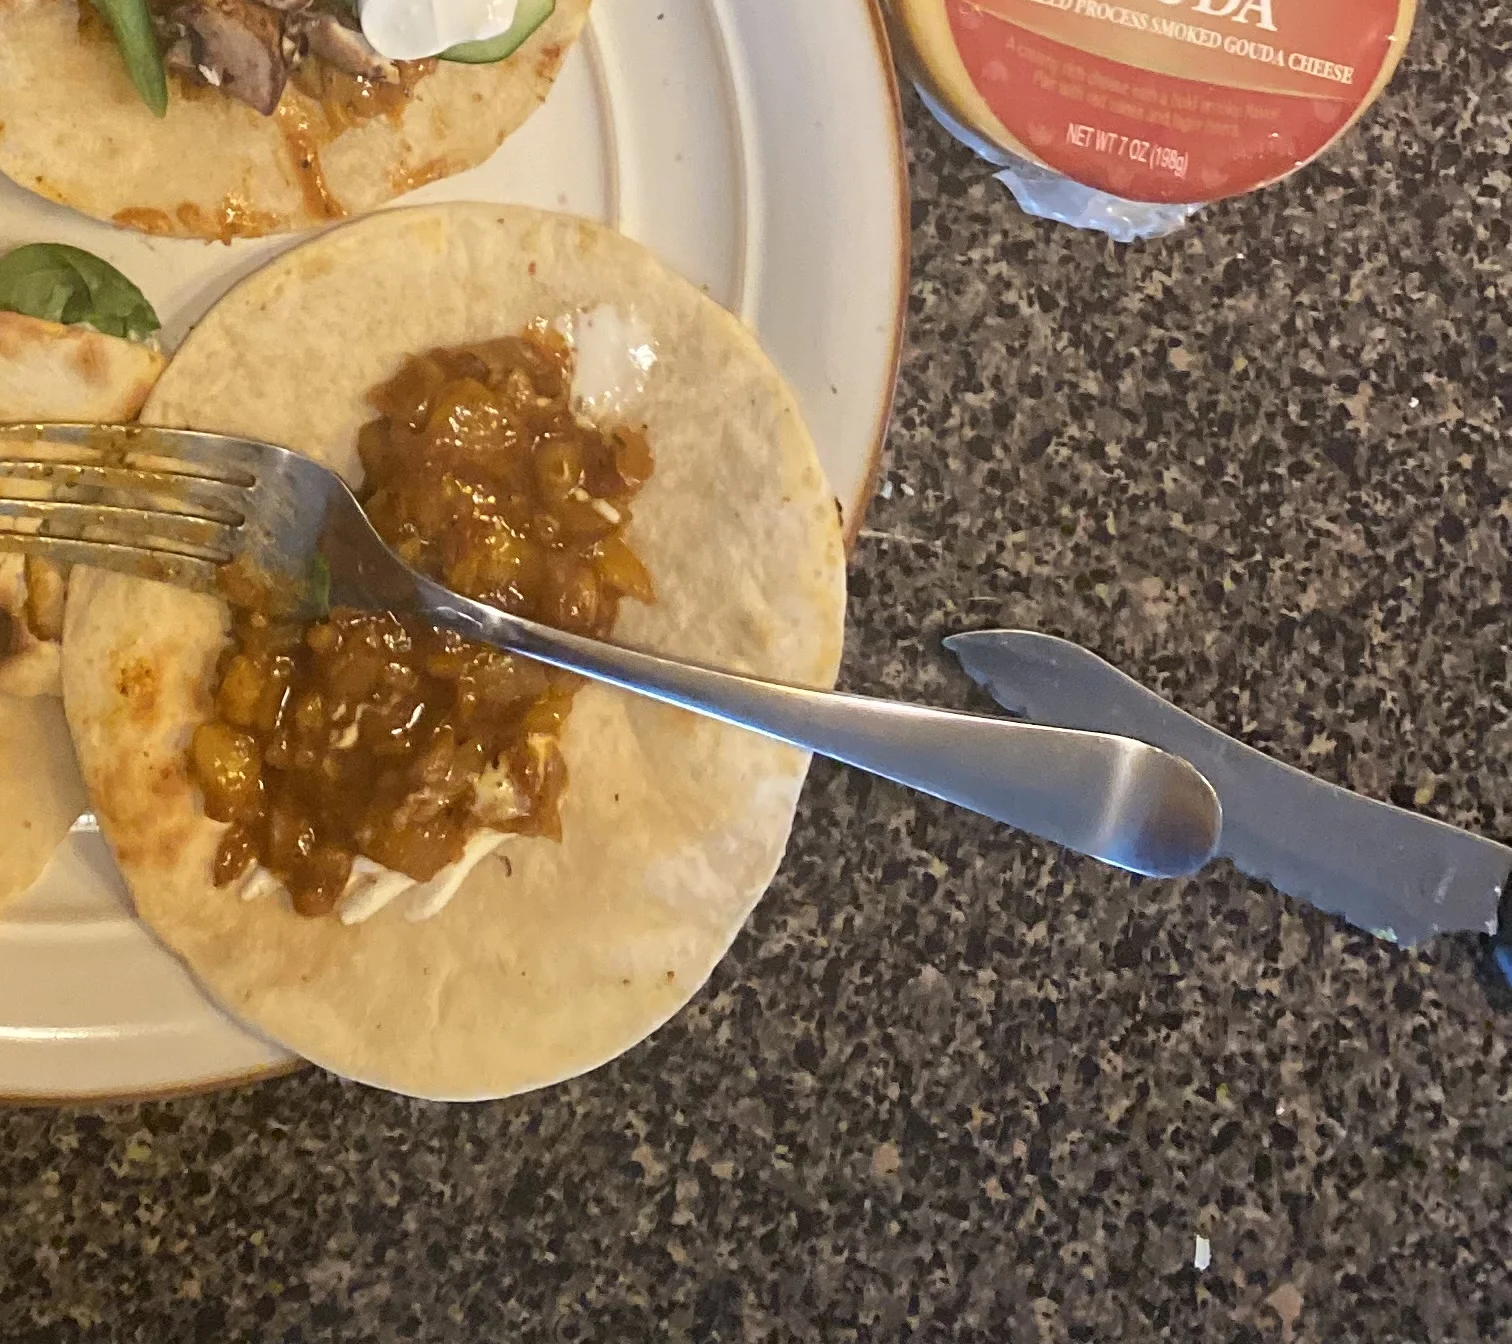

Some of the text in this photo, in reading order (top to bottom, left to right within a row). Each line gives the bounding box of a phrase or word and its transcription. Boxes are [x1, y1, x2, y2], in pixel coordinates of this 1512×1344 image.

[1151, 16, 1222, 49] SMOKED
[1223, 35, 1285, 67] GOUDA
[1288, 52, 1355, 85] CHEESE
[1066, 122, 1189, 180] NET WT 7 OZ (198g)
